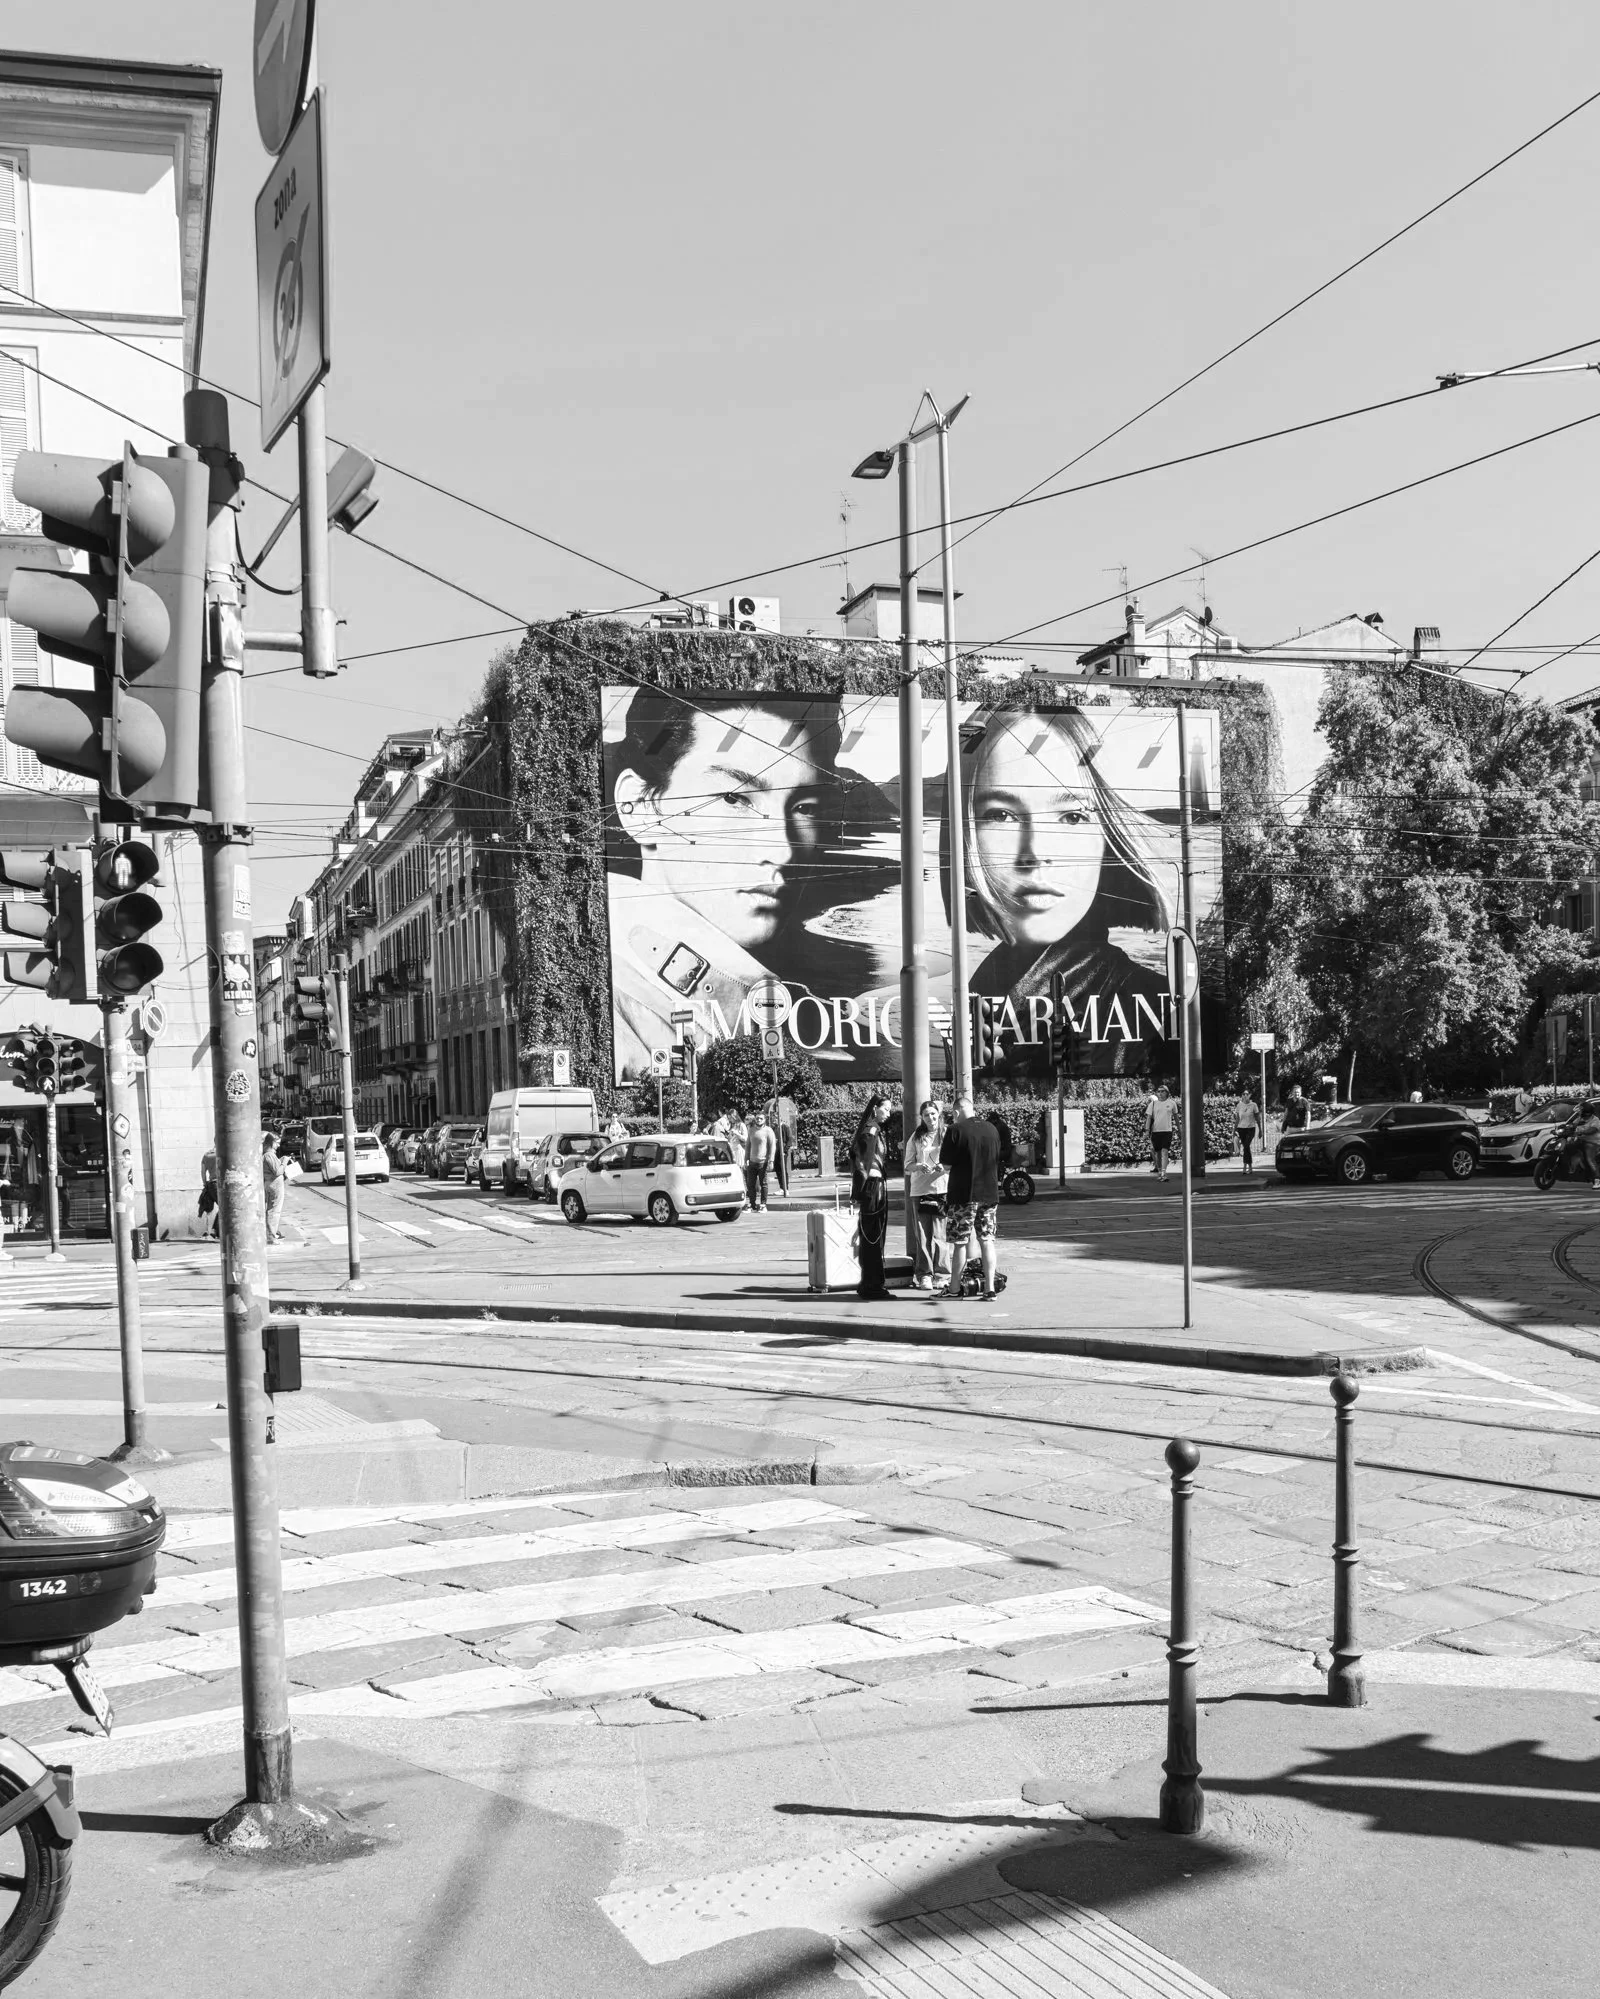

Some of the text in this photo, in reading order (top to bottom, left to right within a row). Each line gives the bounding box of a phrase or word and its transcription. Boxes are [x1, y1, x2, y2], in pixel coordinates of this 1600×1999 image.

[274, 167, 297, 230] zona
[673, 993, 1181, 1052] EMORI ARMANI
[20, 1579, 67, 1597] 1342
